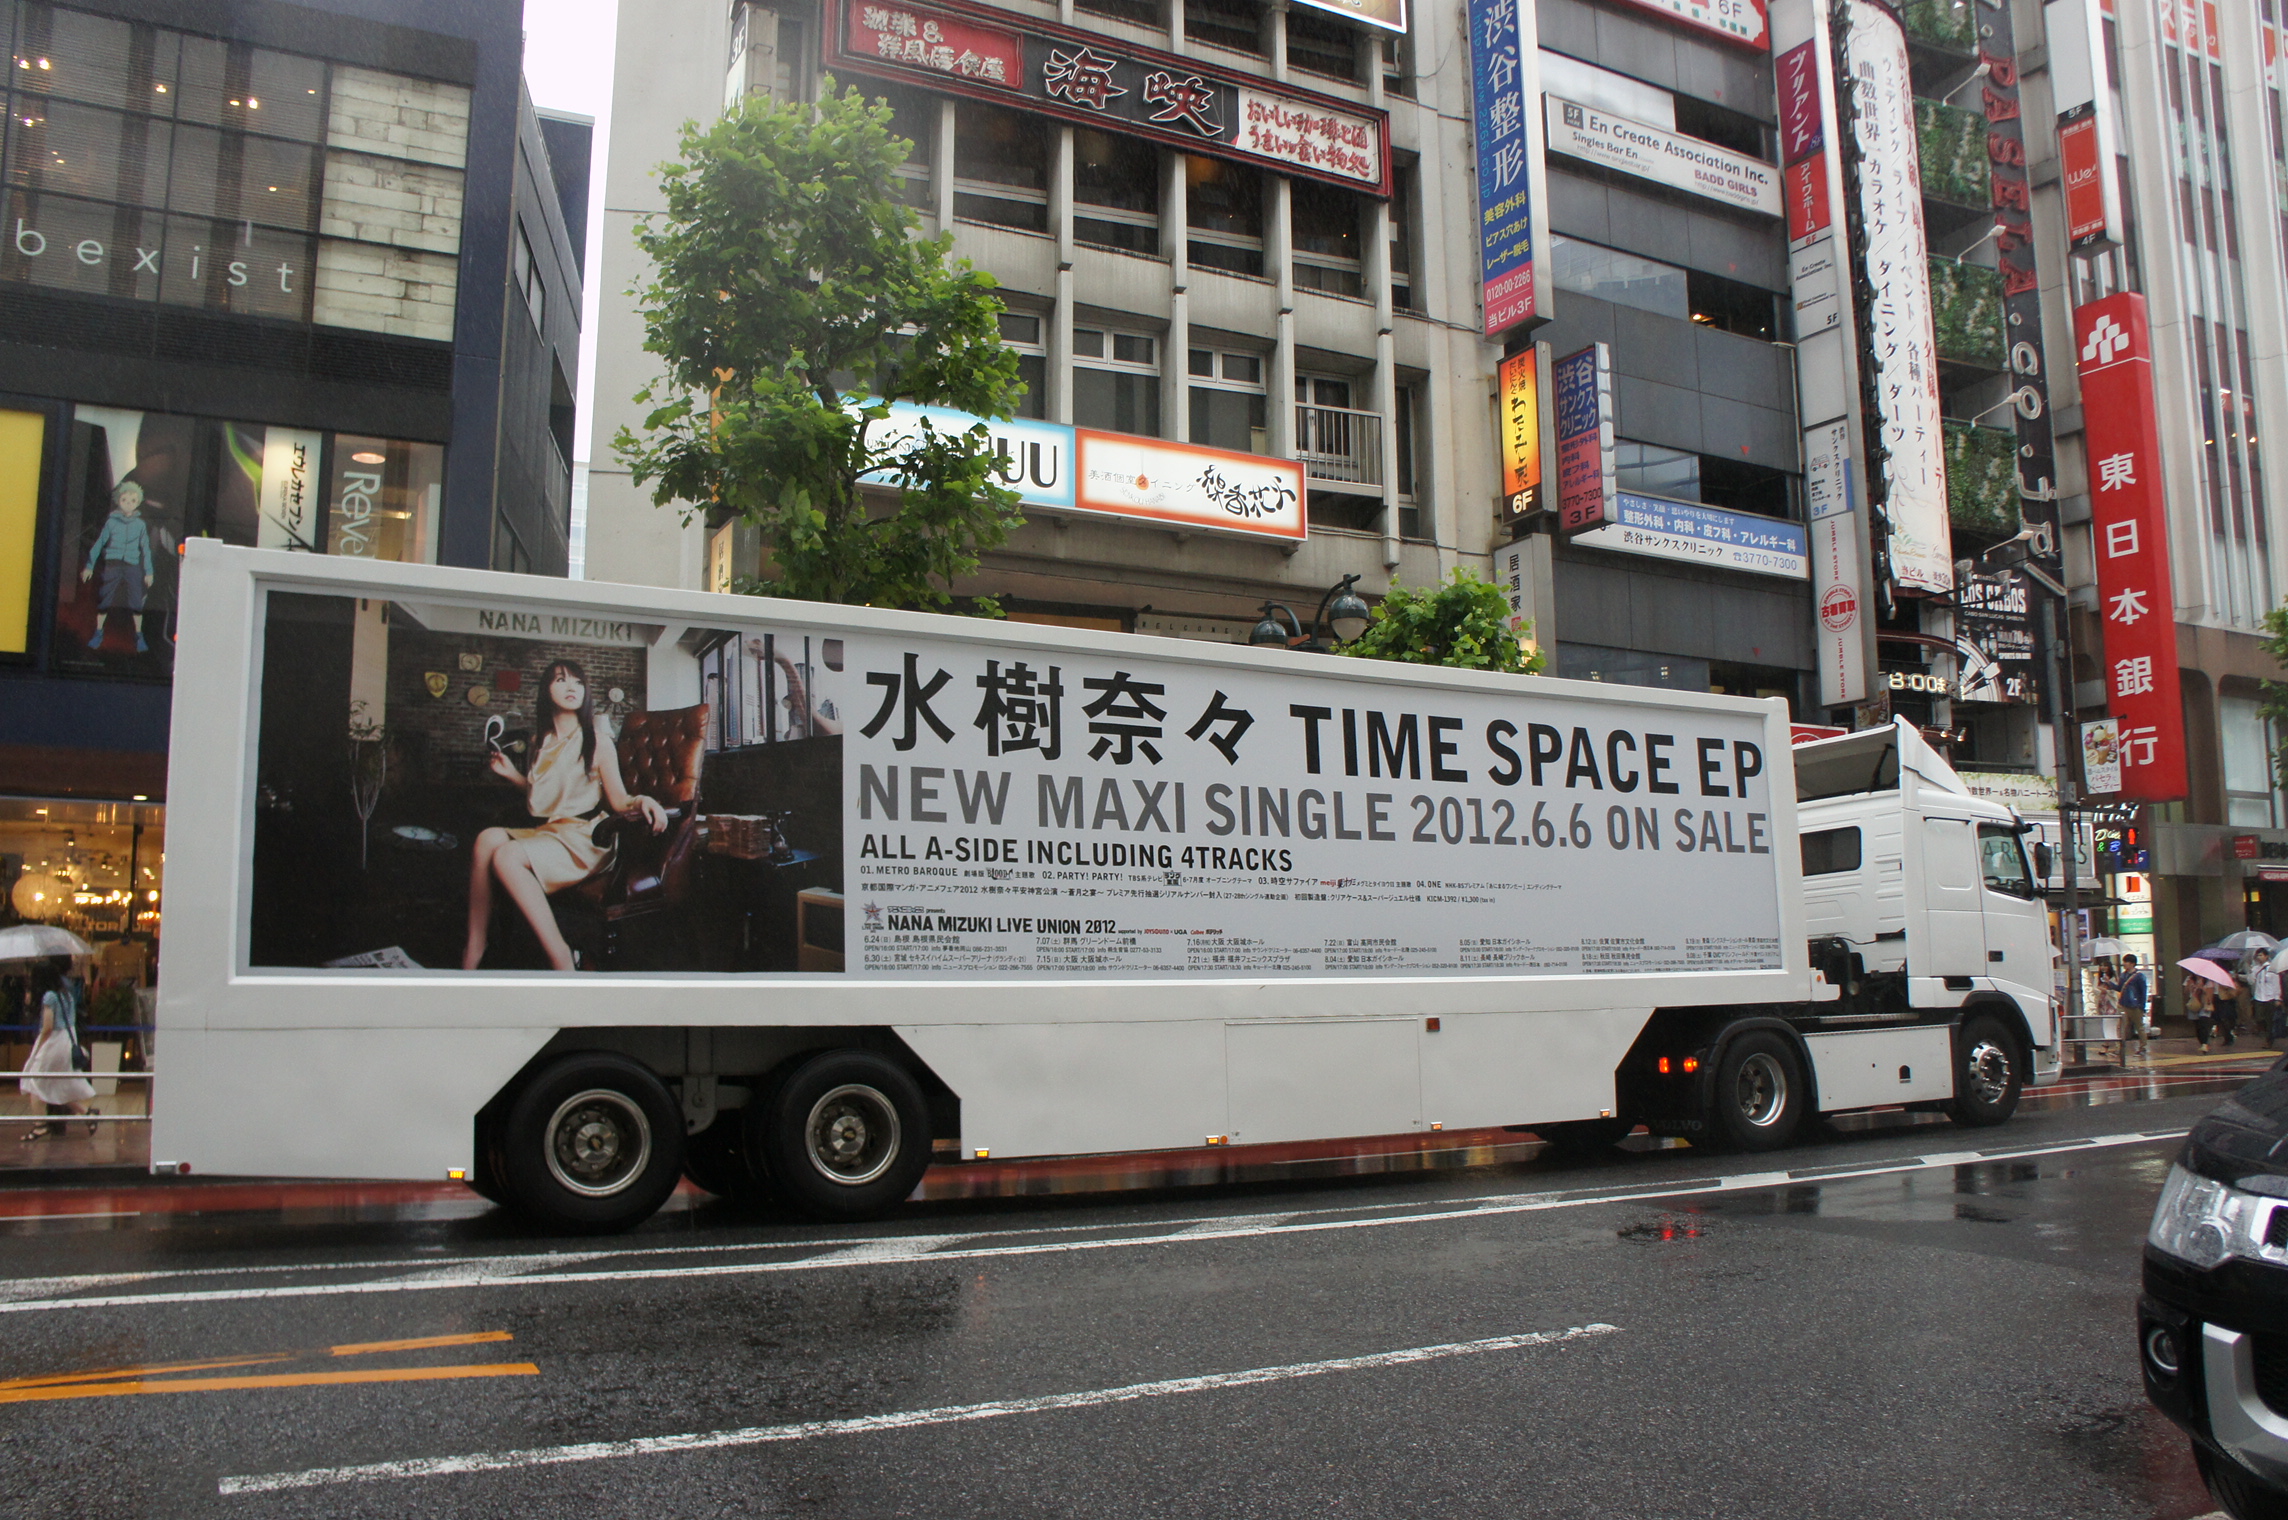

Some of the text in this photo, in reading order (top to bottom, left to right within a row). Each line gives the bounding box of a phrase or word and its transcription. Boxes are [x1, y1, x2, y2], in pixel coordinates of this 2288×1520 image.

[1484, 0, 1523, 193] 渋谷整形
[1566, 106, 1580, 119] 5F
[2068, 106, 2083, 118] 5F
[1572, 131, 1605, 150] Singles
[1607, 143, 1625, 156] Bar
[1626, 147, 1638, 159] En
[1590, 115, 1608, 134] En
[1613, 123, 1661, 150] Create
[1664, 140, 1741, 176] Association
[1745, 166, 1769, 186] Inc.
[1694, 169, 1726, 187] BADD
[1728, 180, 1758, 198] GIRLS
[1800, 162, 1816, 231] アイワホーム
[1484, 190, 1526, 226] 美容外科
[1486, 216, 1528, 248] ピアス穴あけ
[2081, 233, 2096, 246] 4F
[15, 218, 294, 293] bexist
[1487, 239, 1529, 270] レーザー脱毛
[1486, 269, 1531, 302] 0120-00-2266
[1488, 296, 1533, 329] 当ビル3F
[1827, 312, 1838, 325] 5F
[1558, 356, 1594, 394] 渋谷
[1560, 386, 1596, 417] サンクス
[1560, 408, 1598, 438] クリニック
[1561, 432, 1598, 454] 整形外科
[1562, 453, 1580, 465] 内科
[1512, 490, 1533, 514] 6F
[1562, 487, 1602, 510] 3770-7300
[1813, 504, 1828, 516] 3F
[339, 471, 380, 559] Reve
[1570, 506, 1596, 524] 3F
[1623, 509, 1796, 552] 整形外科・内科・皮フ科・アレルギー科
[1623, 530, 1724, 558] 渋谷サンクスクリニック
[1830, 520, 1838, 552] JUMBLE
[1742, 551, 1798, 571] 3770-7300
[1961, 583, 1984, 609] LOS
[2098, 451, 2158, 768] 東日本銀行
[479, 610, 633, 642] NANA MIZUKI
[1142, 621, 1229, 634] WELCOME
[2006, 677, 2021, 697] 2F
[859, 652, 1255, 766] 水樹奈々
[1289, 703, 1763, 799] TIME SPACE EP
[860, 763, 1771, 855] NEW MAXI SINGLE 2012.6.6 ON SALE
[860, 833, 1293, 873] ALL A-SIDE INCLUDING 4TRACKS
[860, 865, 874, 875] 01.
[876, 866, 910, 875] METRO
[913, 867, 958, 877] BAROQUE
[1042, 871, 1056, 880] 02.
[1057, 871, 1089, 881] PARTY!
[1092, 872, 1123, 882] PARTY!
[1258, 876, 1269, 885] 03.
[1270, 877, 1318, 887] 時空サファイア
[1427, 880, 1442, 889] ONE
[861, 882, 978, 894] 京都国際マンガ・アニメフェア2012
[980, 887, 1058, 896] 水樹奈々平安神宮公演
[888, 915, 934, 931] NANA
[937, 917, 993, 932] MIZUKI
[997, 917, 1033, 933] LIVE
[1036, 919, 1081, 934] UNION
[1085, 919, 1116, 934] 2012
[894, 936, 910, 944] 島根
[913, 936, 961, 945] 島根県民会館
[1226, 938, 1265, 946] 大阪城ホール
[1063, 956, 1078, 964] 大阪
[1081, 956, 1122, 964] 大阪城ホール
